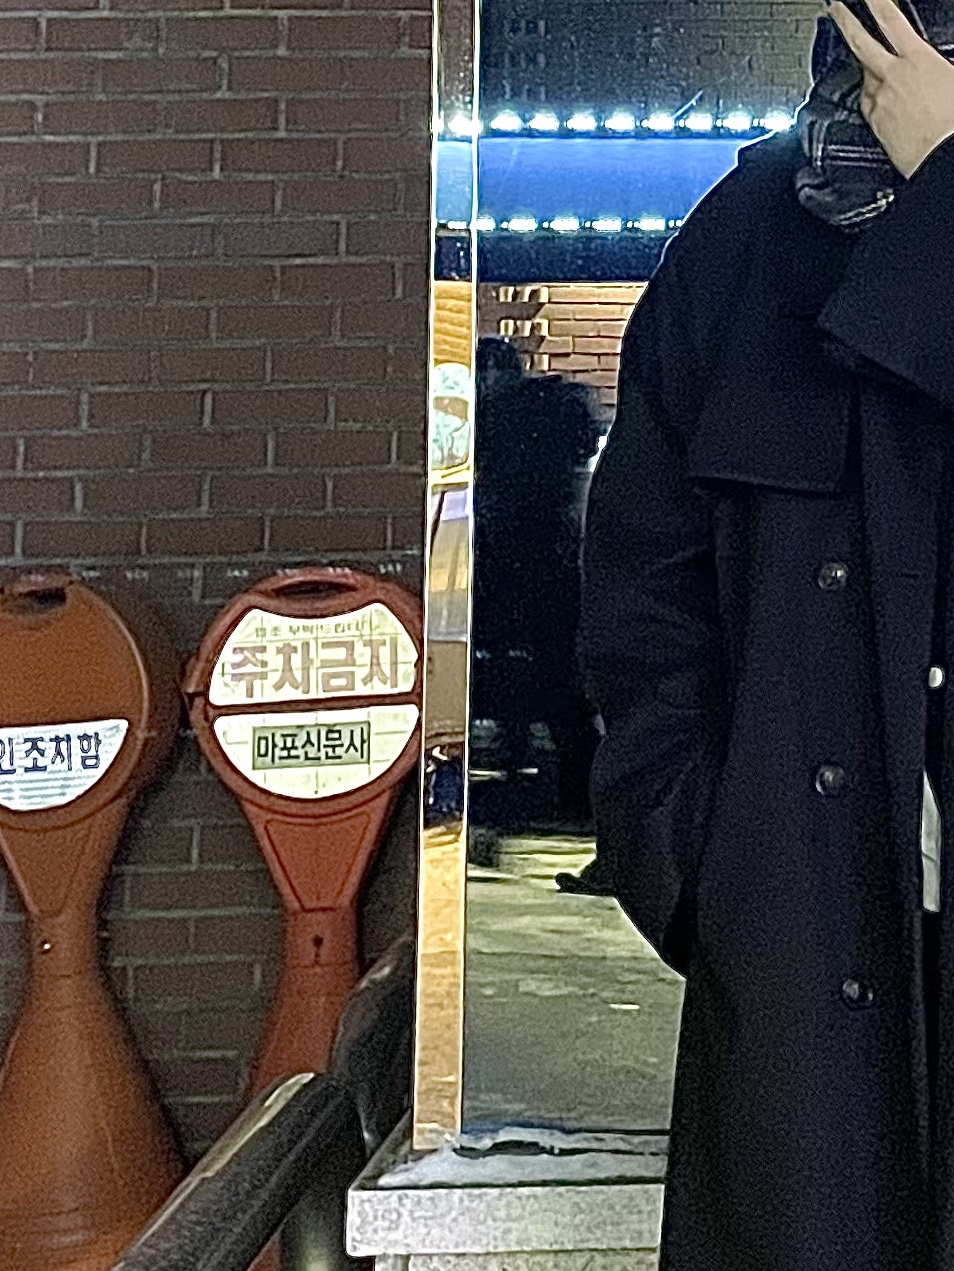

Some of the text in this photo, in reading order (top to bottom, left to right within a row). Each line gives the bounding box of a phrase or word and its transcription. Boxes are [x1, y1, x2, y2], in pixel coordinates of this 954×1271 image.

[231, 636, 399, 699] 주차금지
[0, 732, 102, 774] 인조치함
[257, 726, 367, 764] 마포신문사
